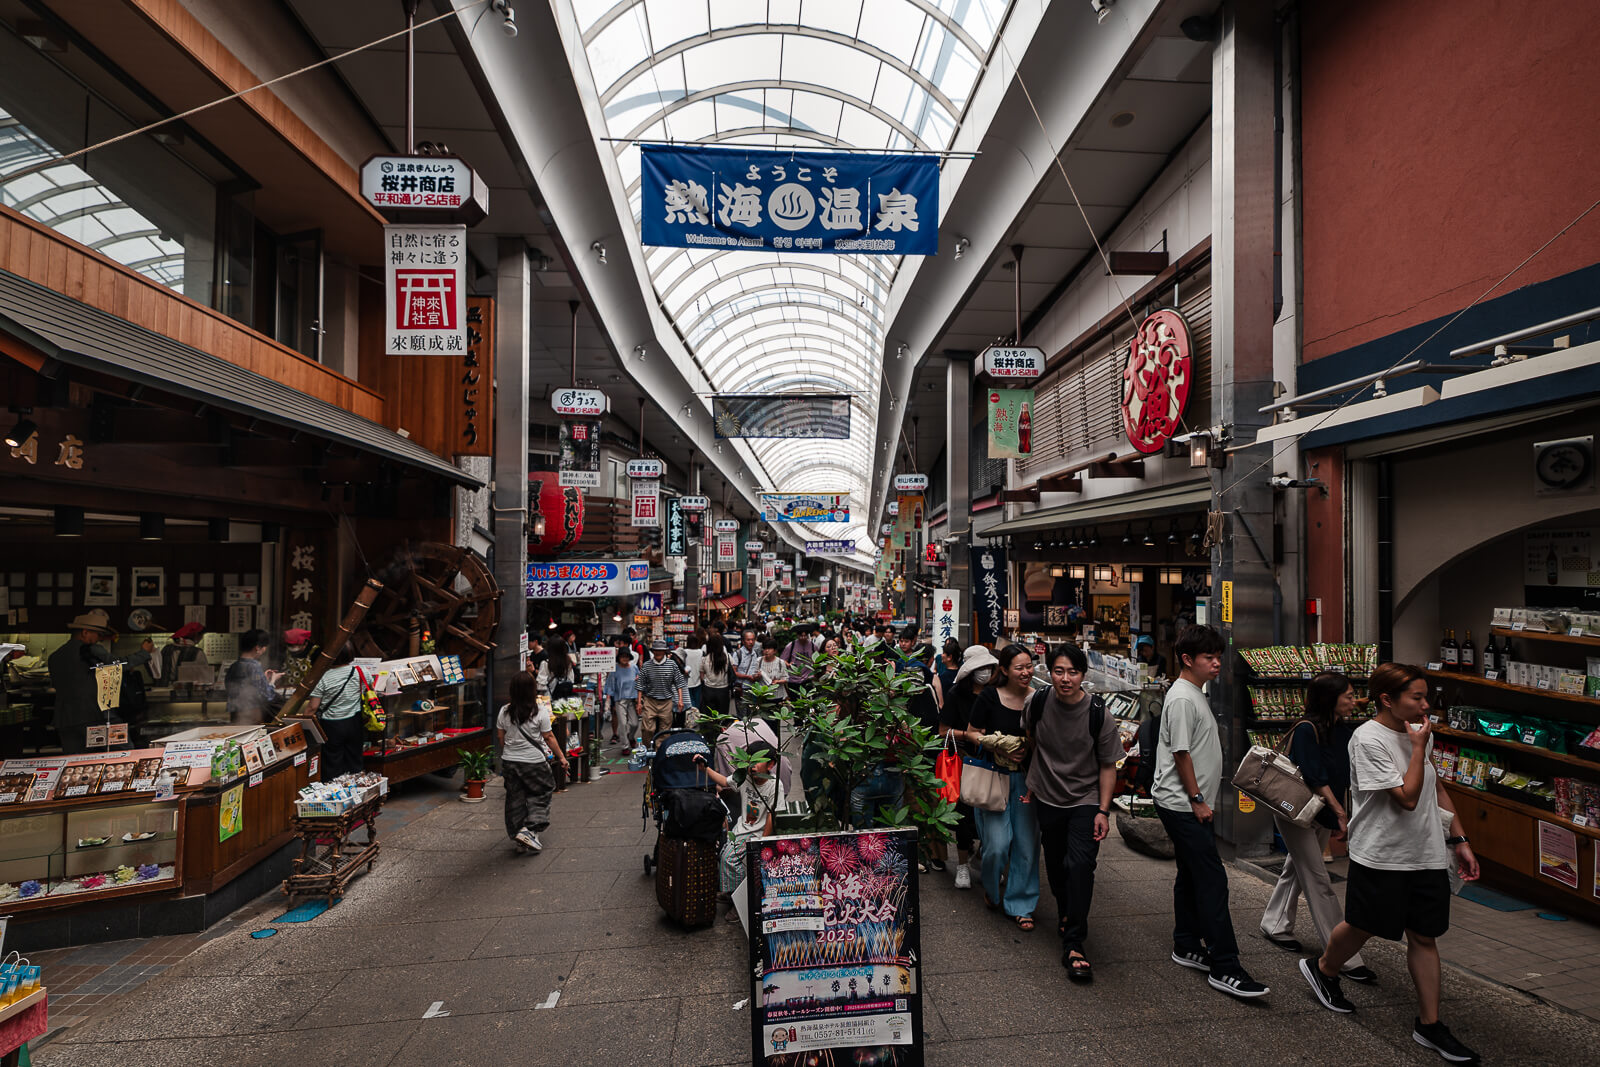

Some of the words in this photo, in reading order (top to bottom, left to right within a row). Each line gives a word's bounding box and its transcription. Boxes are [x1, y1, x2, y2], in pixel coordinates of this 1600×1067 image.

[397, 163, 455, 173] 温泉まんじゅう
[745, 164, 839, 184] ようこそ
[381, 175, 455, 193] 桜井商店
[374, 193, 461, 206] 平和通り名店街
[391, 233, 460, 248] 自然に宿る
[686, 234, 725, 245] Welcome
[727, 236, 737, 245] to
[738, 237, 764, 247] Atami
[391, 250, 460, 265] 神々に逢う
[391, 335, 463, 351] 來願成就
[994, 358, 1035, 368] 桜井商店
[670, 502, 683, 553] お食事処
[939, 613, 956, 646] 鈴廣
[816, 928, 856, 943] 2025
